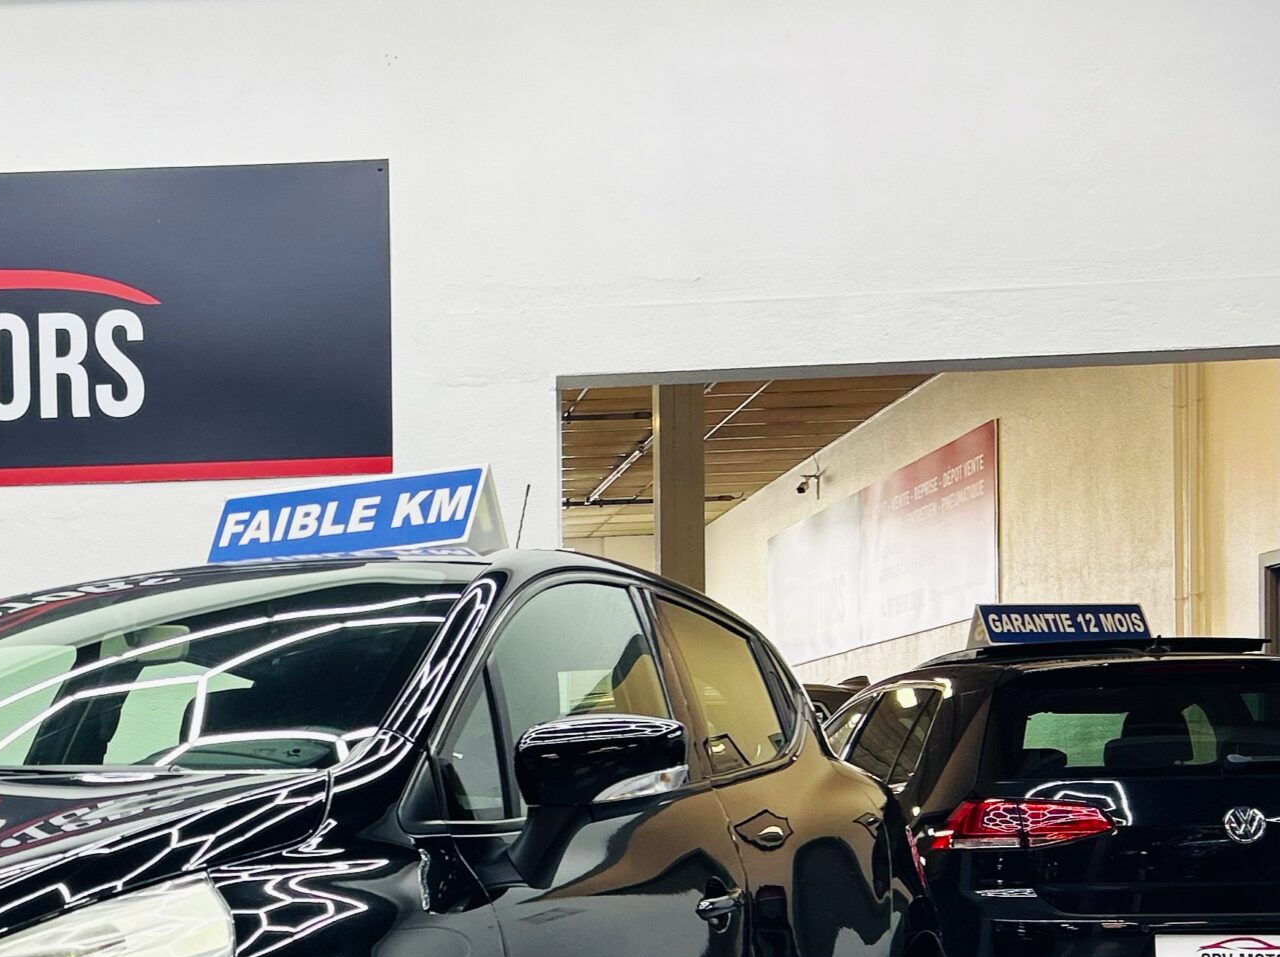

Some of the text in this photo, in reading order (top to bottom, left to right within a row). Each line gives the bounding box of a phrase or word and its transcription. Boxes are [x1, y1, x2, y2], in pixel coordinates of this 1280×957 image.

[963, 453, 984, 478] VENTE
[218, 485, 473, 548] FAIBLE KM
[988, 612, 1145, 633] GARANTIE 12 MOIS
